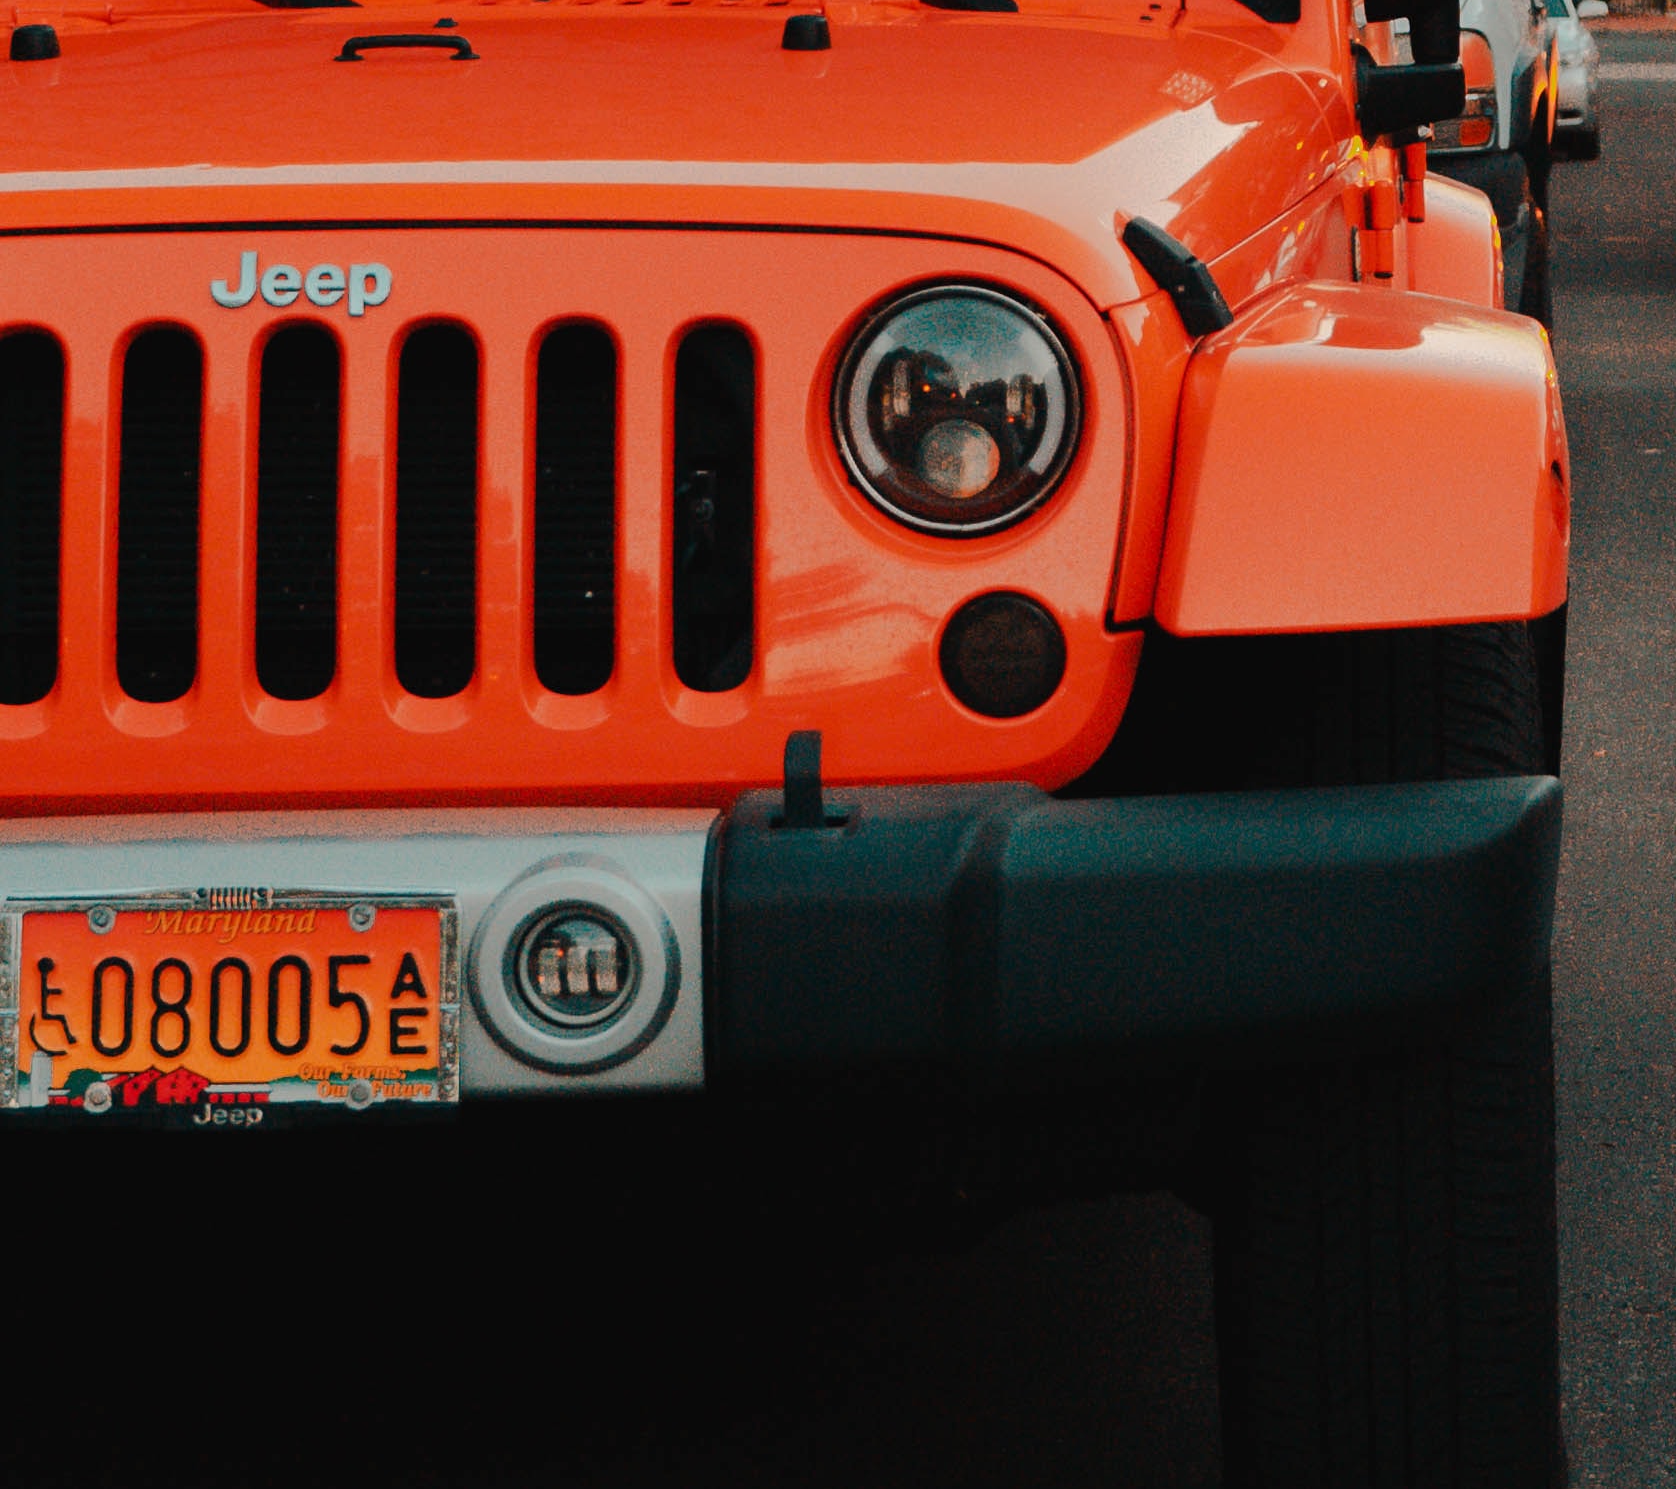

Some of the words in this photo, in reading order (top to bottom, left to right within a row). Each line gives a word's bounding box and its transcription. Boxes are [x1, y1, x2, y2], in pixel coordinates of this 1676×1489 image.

[210, 250, 393, 317] Jeep
[144, 909, 318, 944] Maryland
[91, 955, 371, 1058] 08005
[299, 1062, 331, 1080] Our
[370, 1080, 433, 1098] Future
[193, 1103, 264, 1126] Jeep
